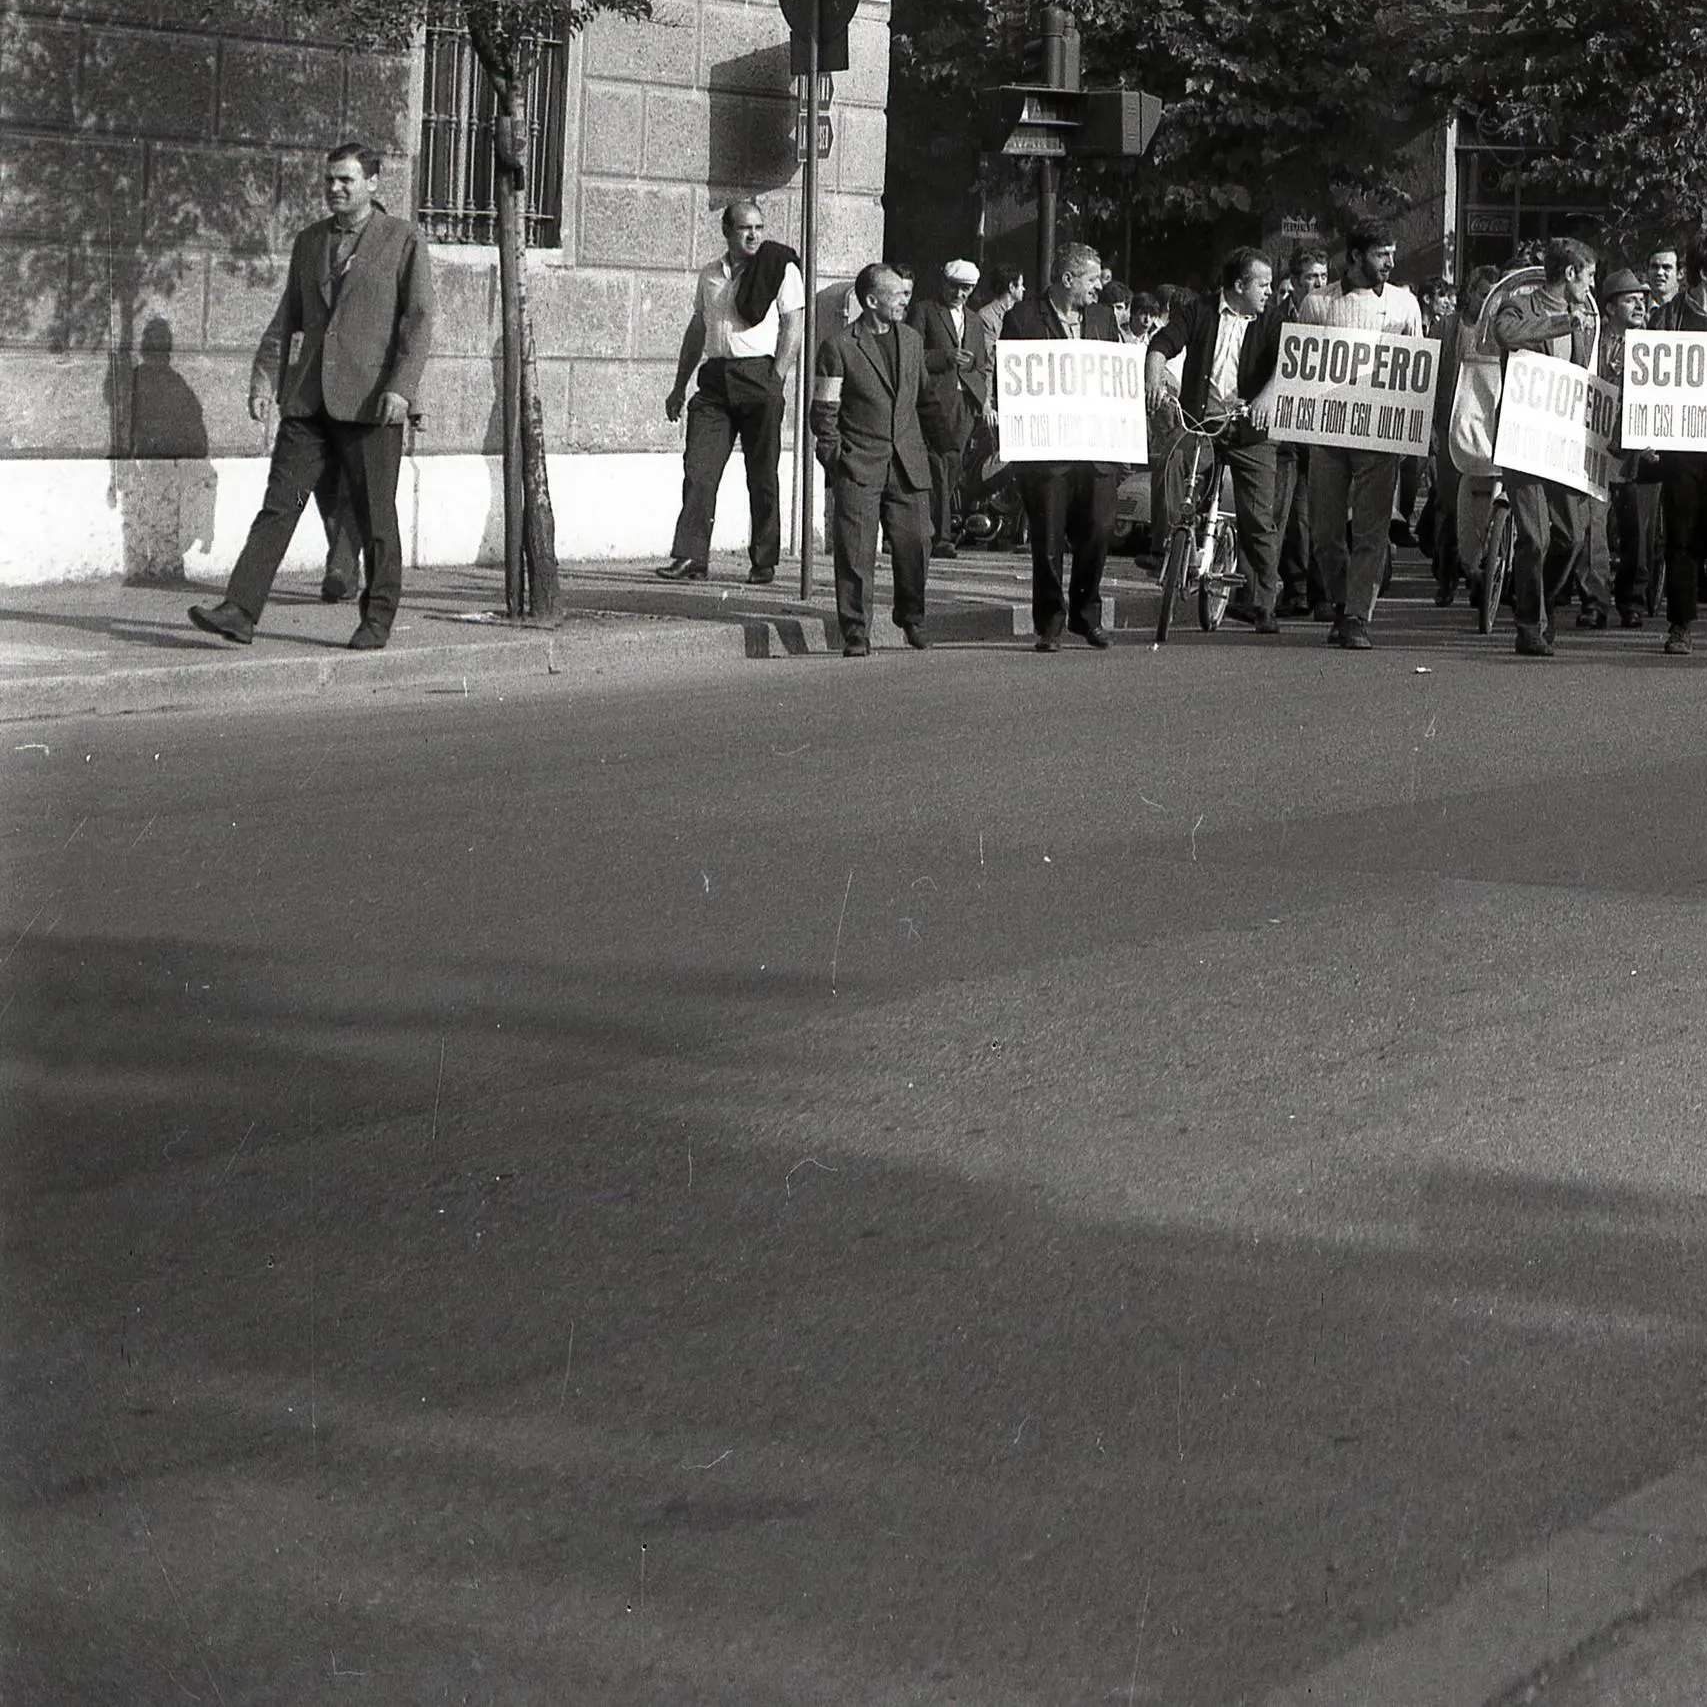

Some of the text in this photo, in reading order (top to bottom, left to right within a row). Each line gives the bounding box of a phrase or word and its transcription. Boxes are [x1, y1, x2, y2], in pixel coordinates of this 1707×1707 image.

[1003, 351, 1140, 400] SCIOPERO
[1281, 335, 1433, 394] SCIOPERO
[1274, 395, 1424, 443] FIM CISL FIOM CGIL UILM UIL
[1628, 403, 1648, 437] FIM
[1653, 404, 1674, 438] CISL
[1681, 405, 1707, 439] FIOM
